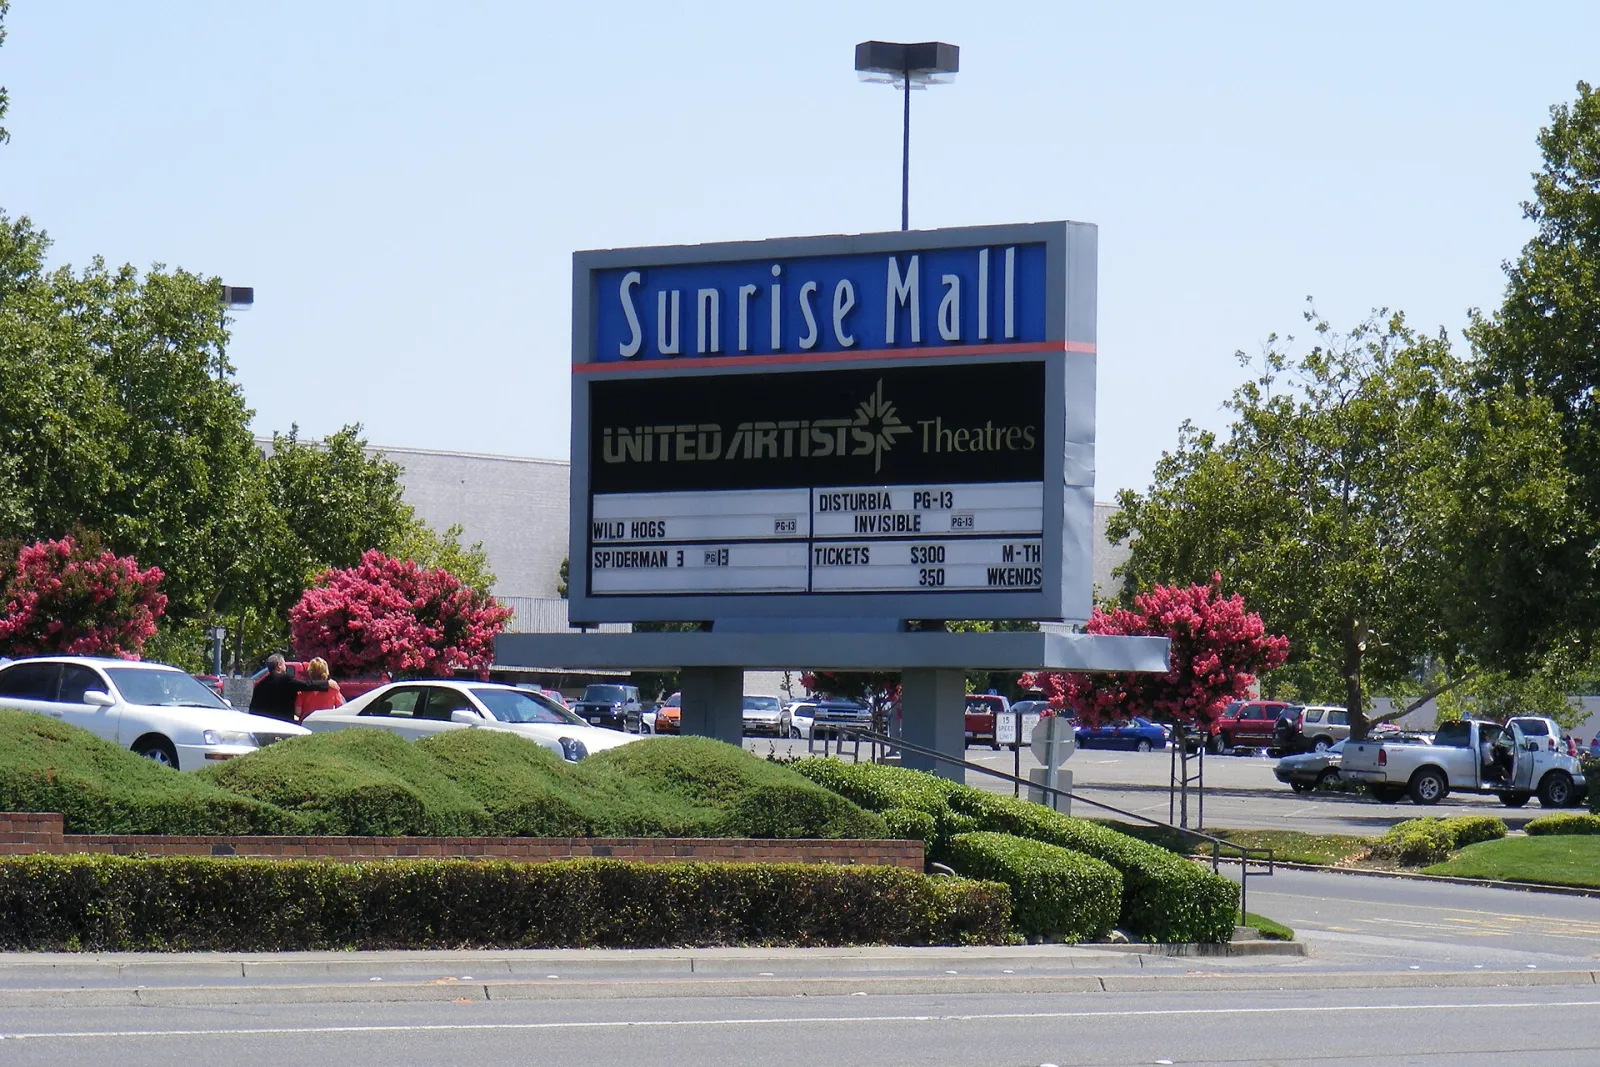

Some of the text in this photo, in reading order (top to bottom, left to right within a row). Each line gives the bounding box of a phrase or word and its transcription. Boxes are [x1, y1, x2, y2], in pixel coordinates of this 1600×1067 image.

[619, 247, 1015, 358] Sunrise Mall
[603, 416, 1035, 464] UNITED ARTISTS Theatres
[819, 491, 953, 512] DISTURBIA PG-13
[593, 521, 796, 539] WILD HOGS PG-13
[854, 515, 973, 533] INVISIBLE PG-13
[594, 550, 668, 569] SPIDERMAN
[677, 550, 684, 568] 3
[814, 547, 870, 565] TICKETS
[919, 567, 1042, 587] 350 WKENDS
[1002, 716, 1010, 724] 15
